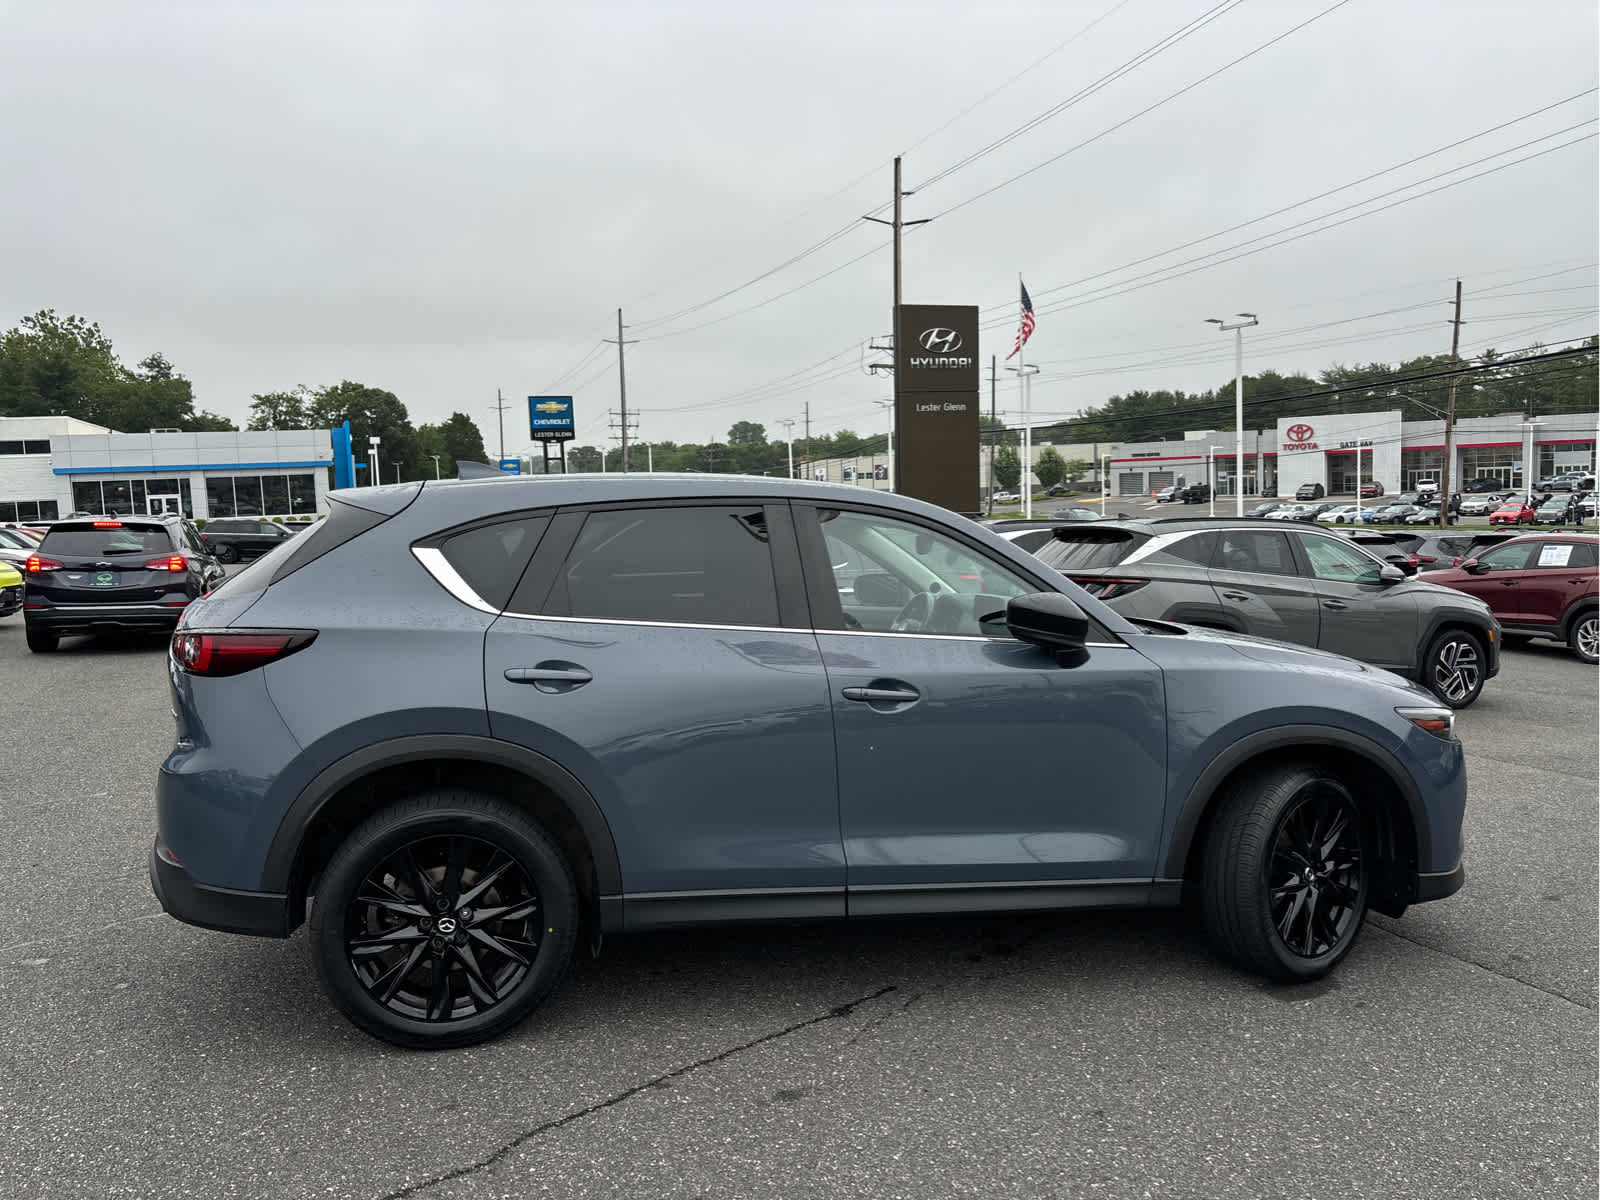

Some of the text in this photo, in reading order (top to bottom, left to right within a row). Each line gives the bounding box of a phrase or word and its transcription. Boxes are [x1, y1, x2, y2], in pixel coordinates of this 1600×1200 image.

[911, 358, 971, 368] HYUNDAI
[916, 402, 967, 412] Lester Glenn
[1282, 442, 1318, 450] TOYOTA
